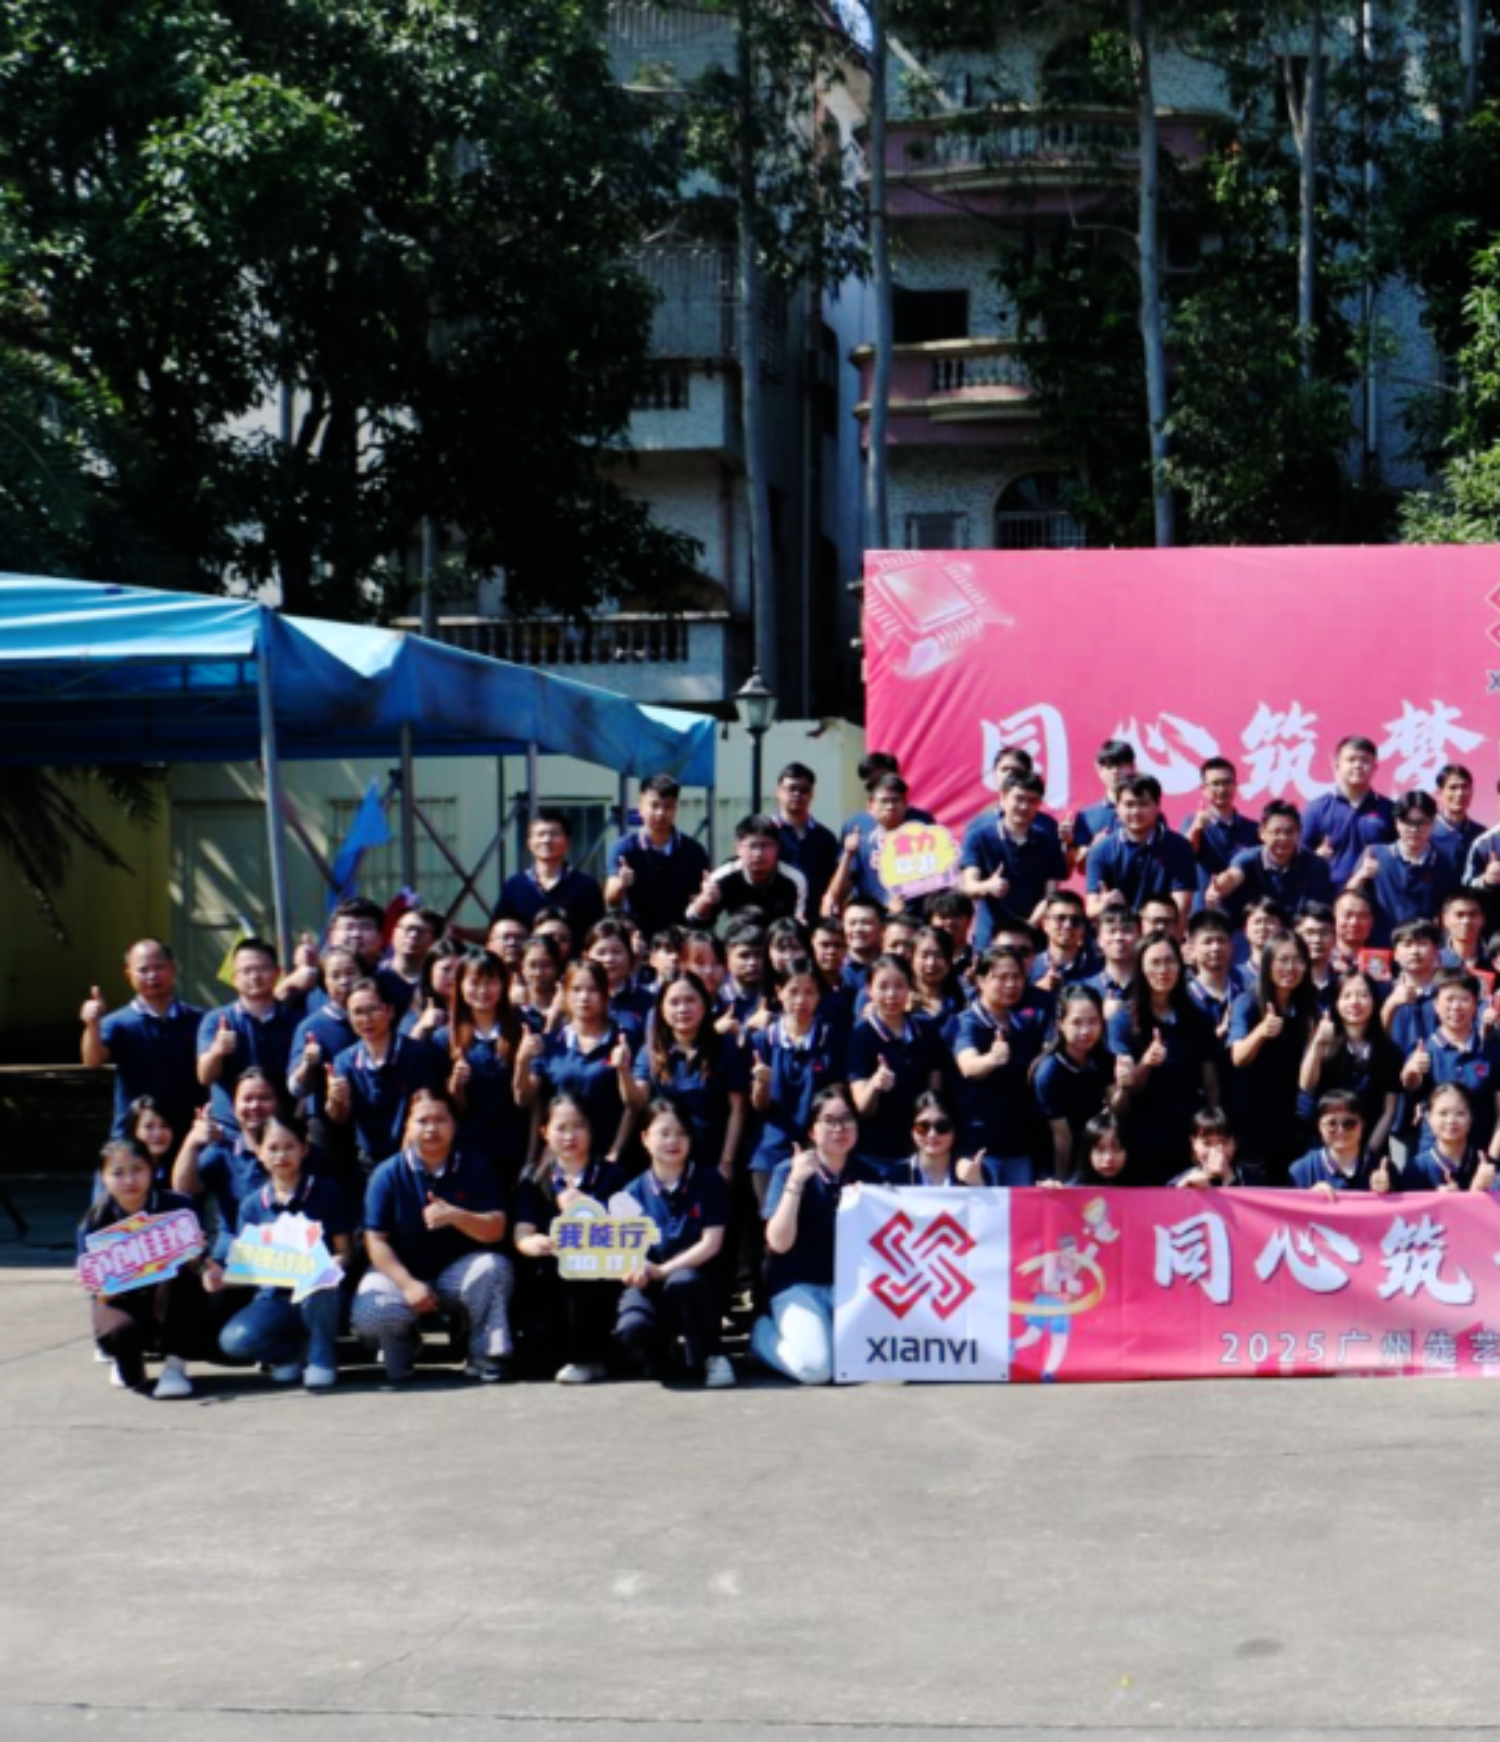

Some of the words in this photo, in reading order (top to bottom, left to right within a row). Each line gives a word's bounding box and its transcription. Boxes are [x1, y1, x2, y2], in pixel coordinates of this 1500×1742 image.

[980, 700, 1486, 809] 同心筑梦
[558, 1222, 648, 1250] 我能行
